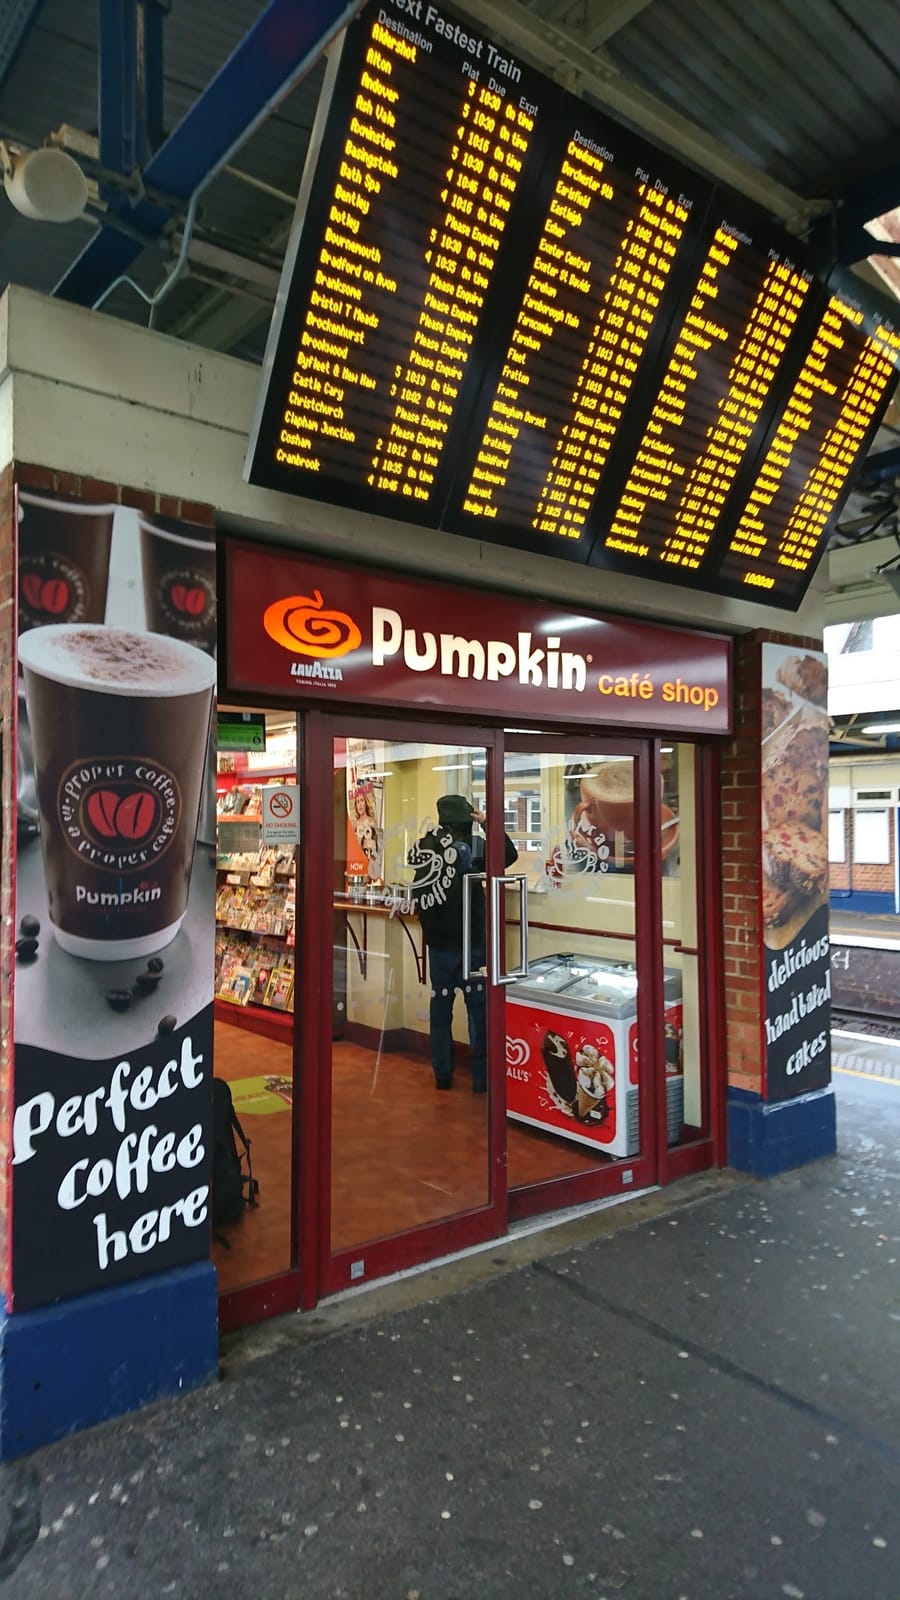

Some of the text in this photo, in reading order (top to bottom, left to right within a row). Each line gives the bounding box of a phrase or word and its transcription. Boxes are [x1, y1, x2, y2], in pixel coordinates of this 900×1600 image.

[378, 9, 539, 116] Destination Plat Due Expt
[390, 0, 522, 82] ext Fastest Train
[573, 130, 614, 163] Destination
[635, 167, 649, 184] Plat
[654, 179, 668, 195] Due
[444, 212, 470, 236] Please
[419, 311, 444, 333] Please
[290, 661, 343, 681] LAVAZZA
[371, 606, 719, 710] Pumpkin café shop
[135, 766, 176, 809] coffee
[62, 805, 75, 822] in
[68, 826, 80, 837] a
[440, 833, 453, 848] a
[350, 863, 364, 871] NOW
[420, 866, 456, 910] coffee
[76, 885, 161, 906] Pumpkin
[768, 934, 830, 993] delicious
[785, 1030, 828, 1076] cakes
[506, 1067, 529, 1083] ALL'S
[12, 1036, 204, 1166] Perfect
[57, 1124, 206, 1210] coffee
[93, 1185, 210, 1271] here
